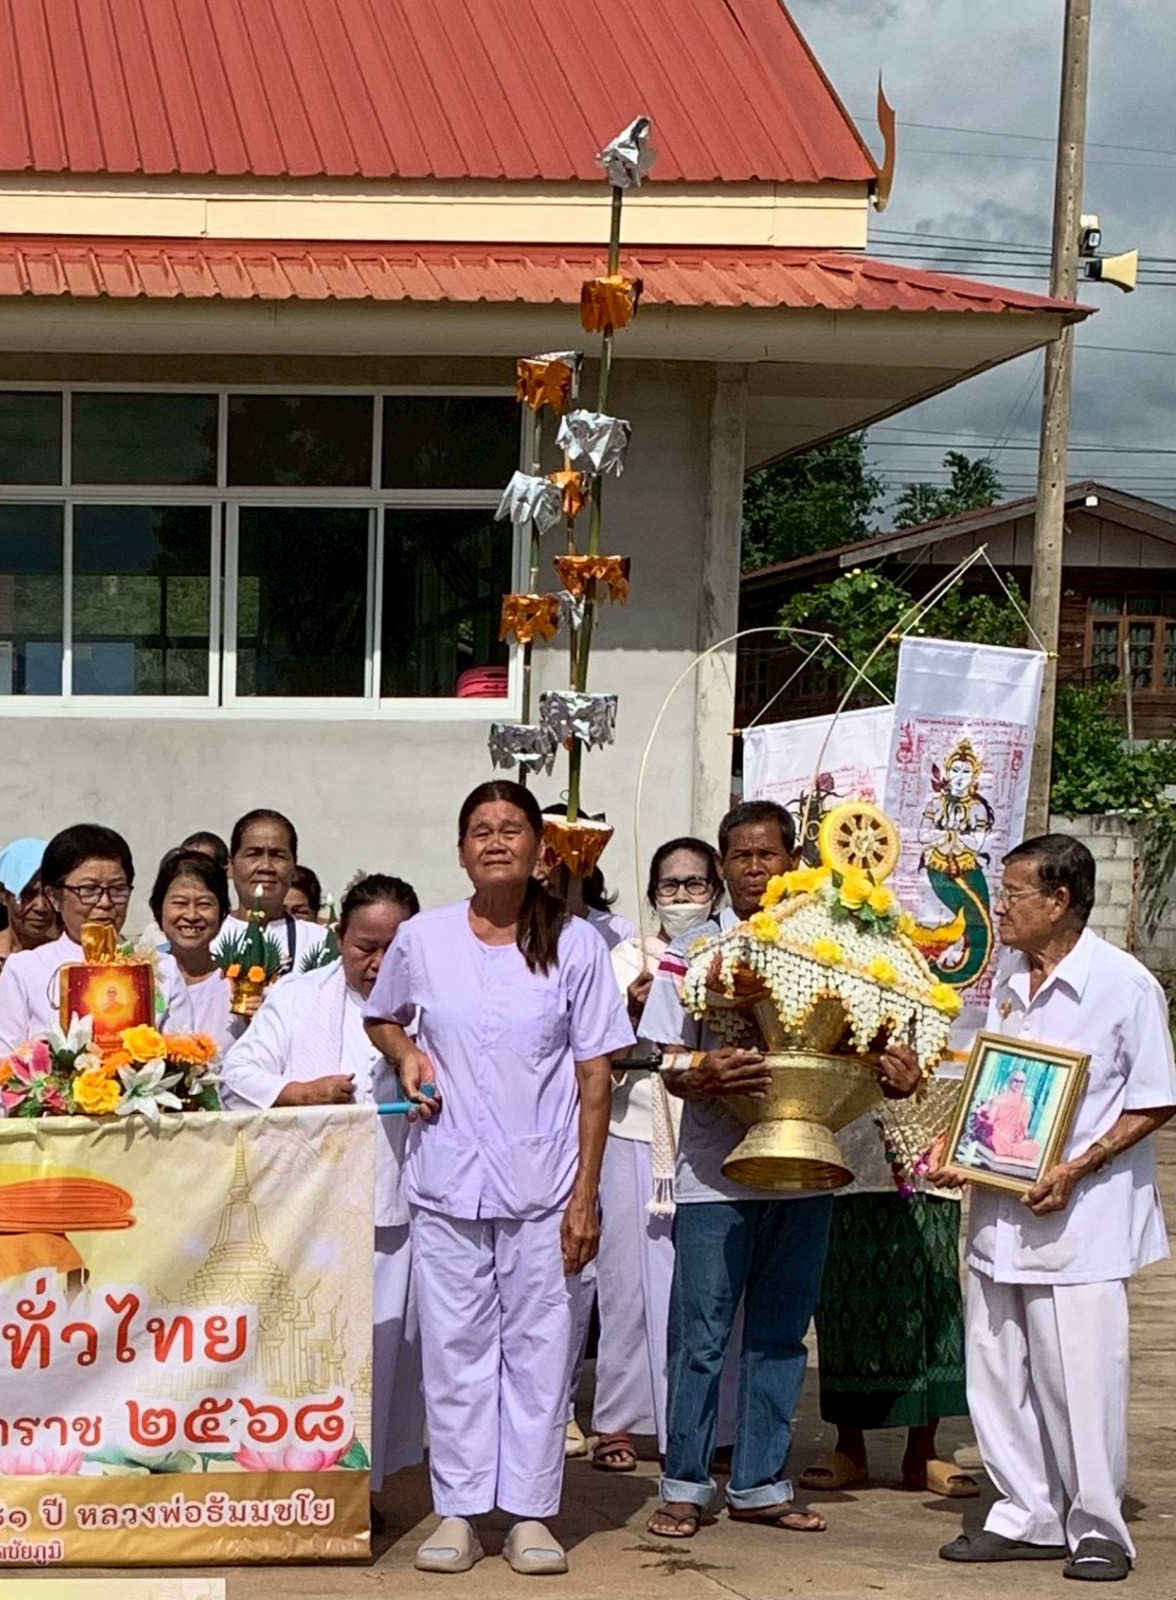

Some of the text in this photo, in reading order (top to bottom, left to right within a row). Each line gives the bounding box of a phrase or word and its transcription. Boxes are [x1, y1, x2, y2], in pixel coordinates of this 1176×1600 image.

[125, 1395, 344, 1447] ๒๕๖๘
[42, 1497, 64, 1526] ปี
[78, 1494, 332, 1526] หลวงพ่อธัมมชโย
